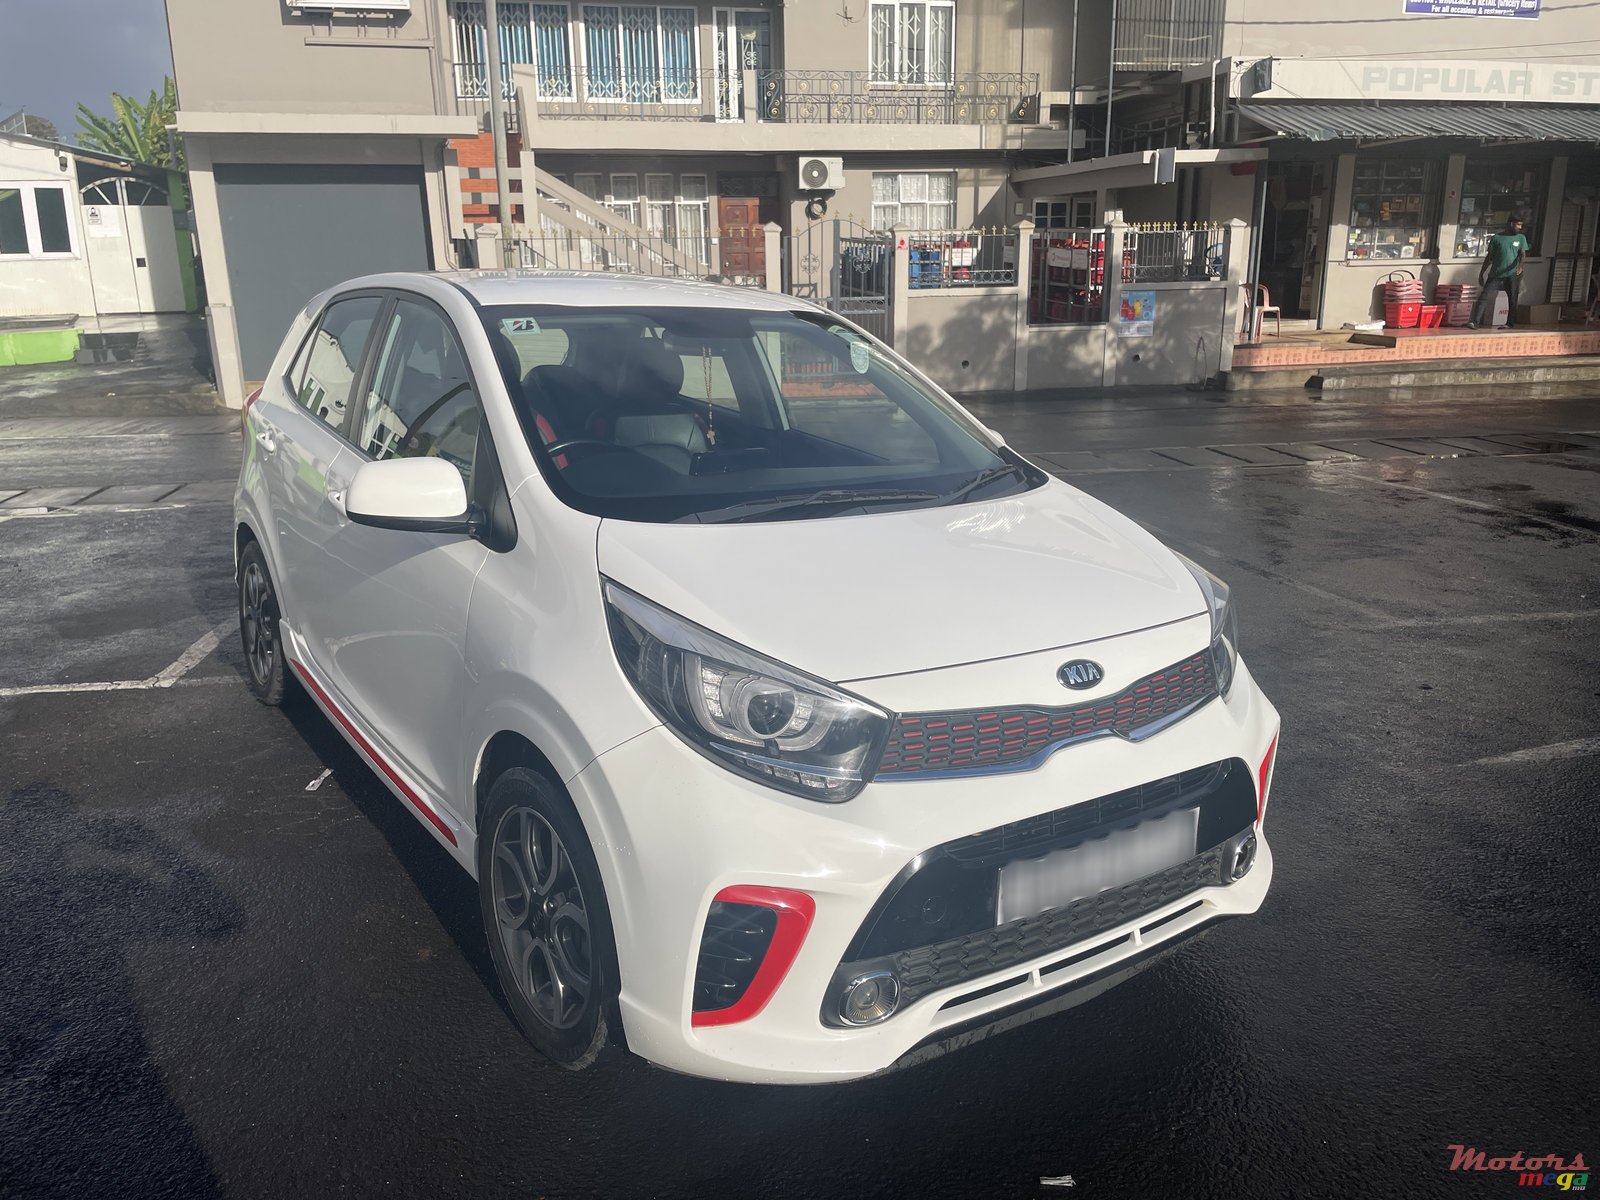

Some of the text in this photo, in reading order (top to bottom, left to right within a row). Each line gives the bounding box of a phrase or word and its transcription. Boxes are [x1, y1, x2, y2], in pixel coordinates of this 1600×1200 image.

[1441, 5, 1450, 13] all
[1450, 6, 1477, 14] occasions
[1361, 66, 1600, 95] POPULAR ST
[1063, 662, 1100, 685] KIA
